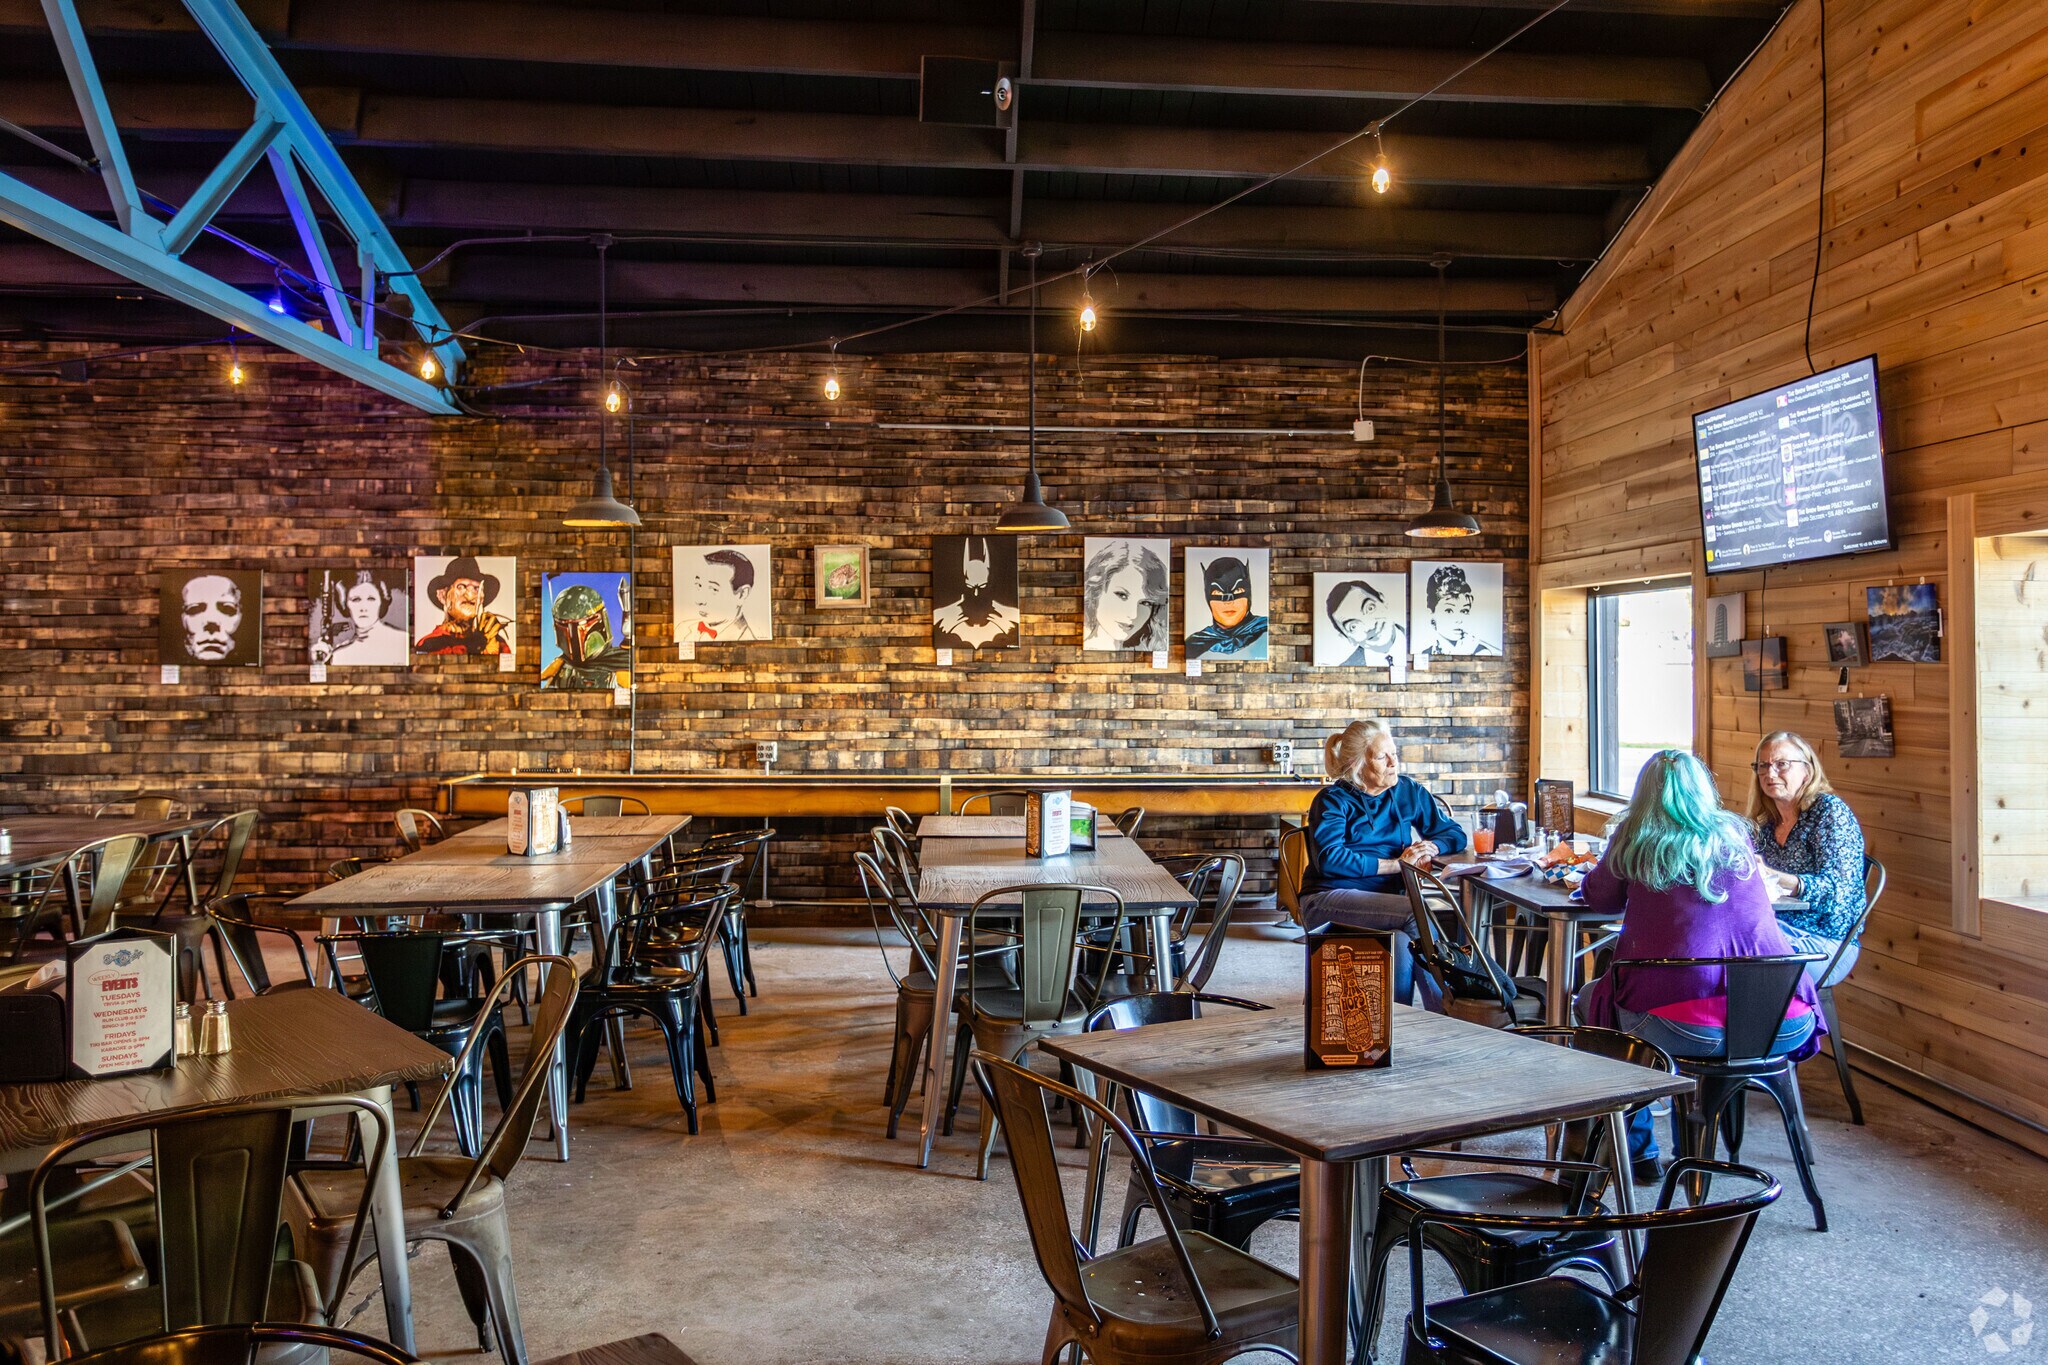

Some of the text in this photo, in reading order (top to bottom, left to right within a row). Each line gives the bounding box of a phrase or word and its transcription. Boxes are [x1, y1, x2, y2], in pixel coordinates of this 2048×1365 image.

[1361, 965, 1380, 976] PUB
[102, 978, 138, 992] EVENTS
[100, 992, 140, 1002] TUESDAYS
[1341, 995, 1364, 1010] HOPS
[94, 1006, 148, 1018] WEDNESDAYS
[104, 1031, 136, 1040] FRIDAYS
[102, 1052, 138, 1062] SUNDAYS
